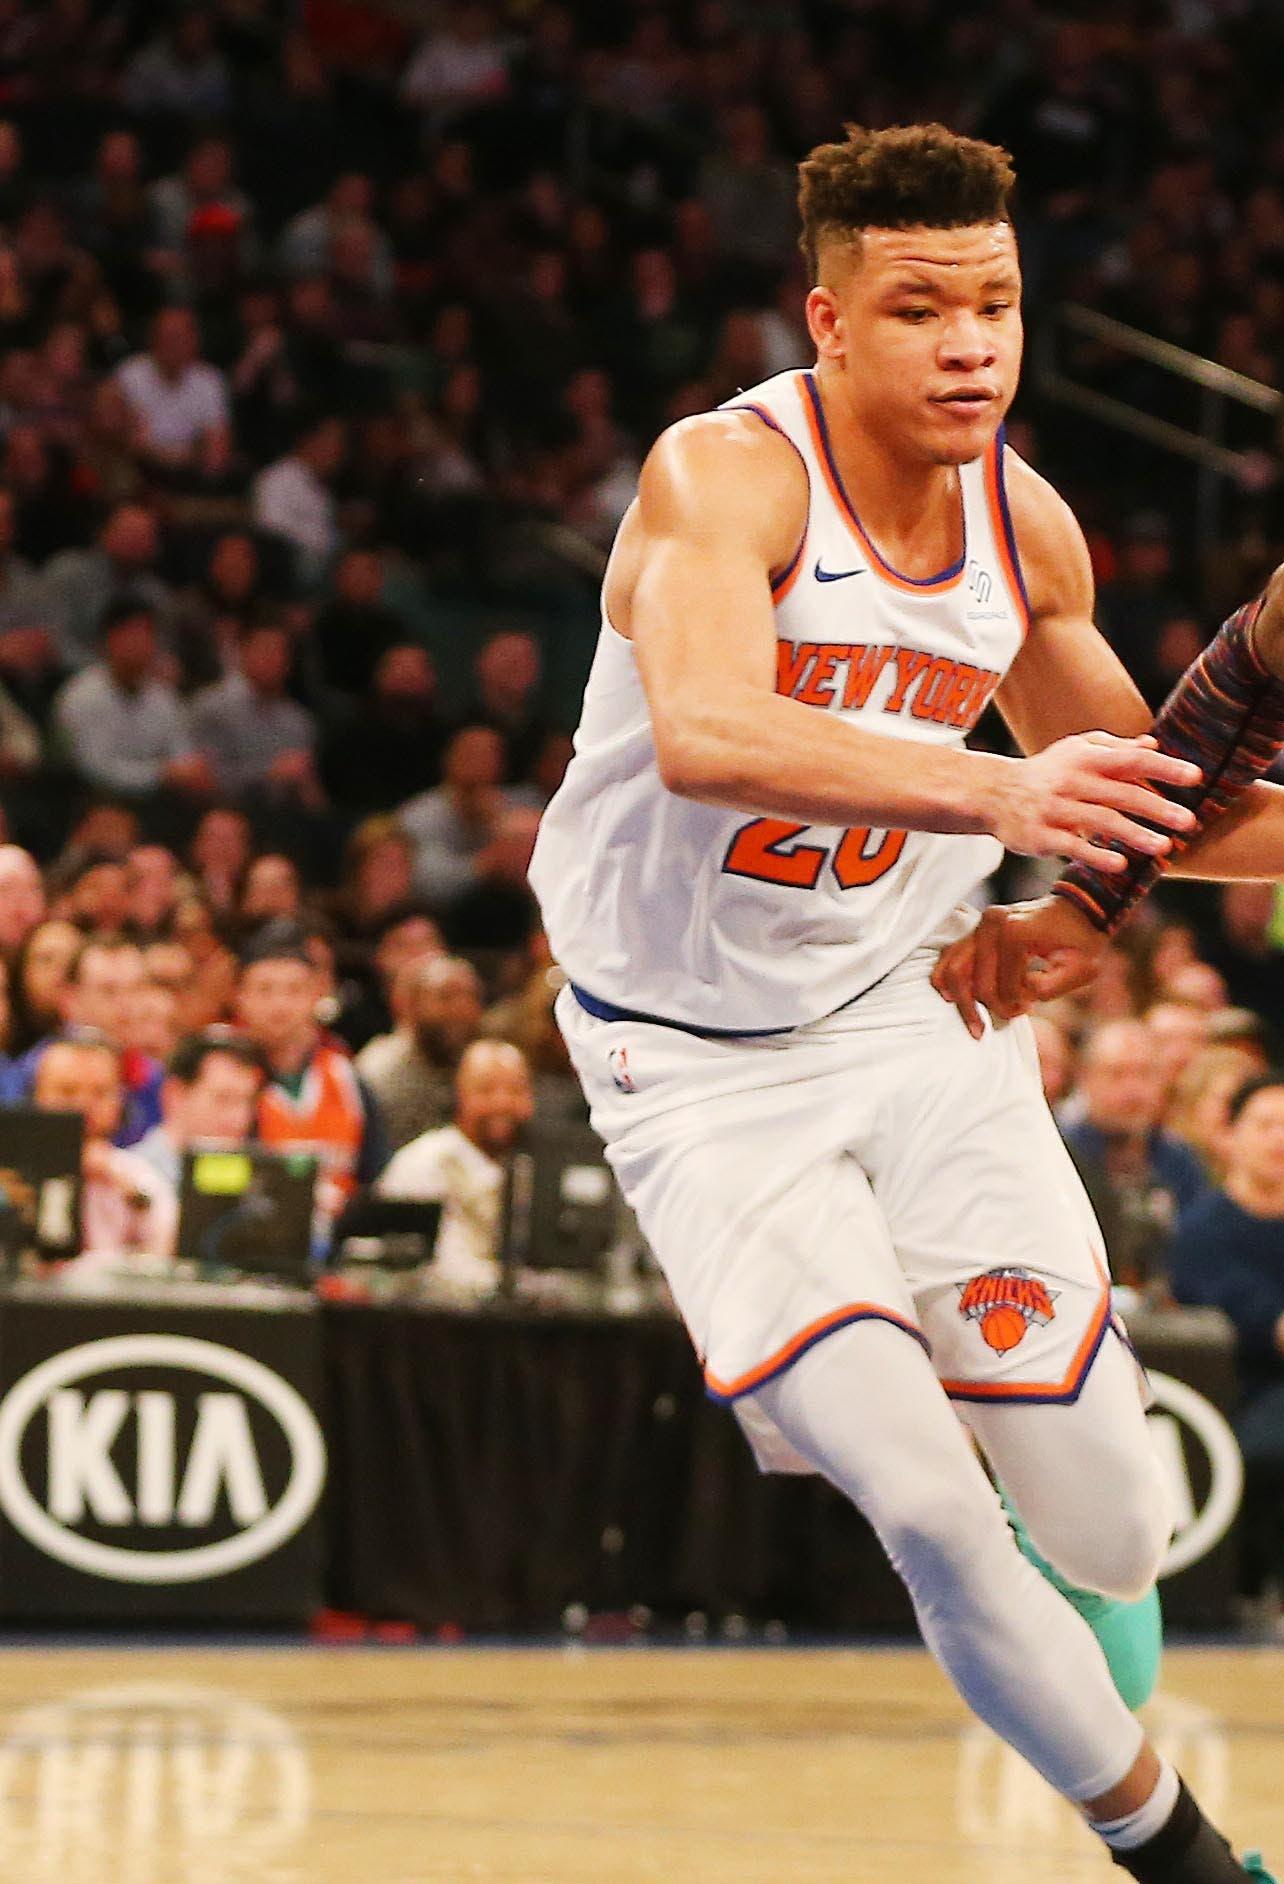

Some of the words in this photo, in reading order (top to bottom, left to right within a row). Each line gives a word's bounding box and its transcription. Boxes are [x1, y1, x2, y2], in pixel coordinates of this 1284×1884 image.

[776, 639, 896, 710] NEW
[883, 647, 1001, 731] YORK
[48, 1388, 268, 1527] KIA
